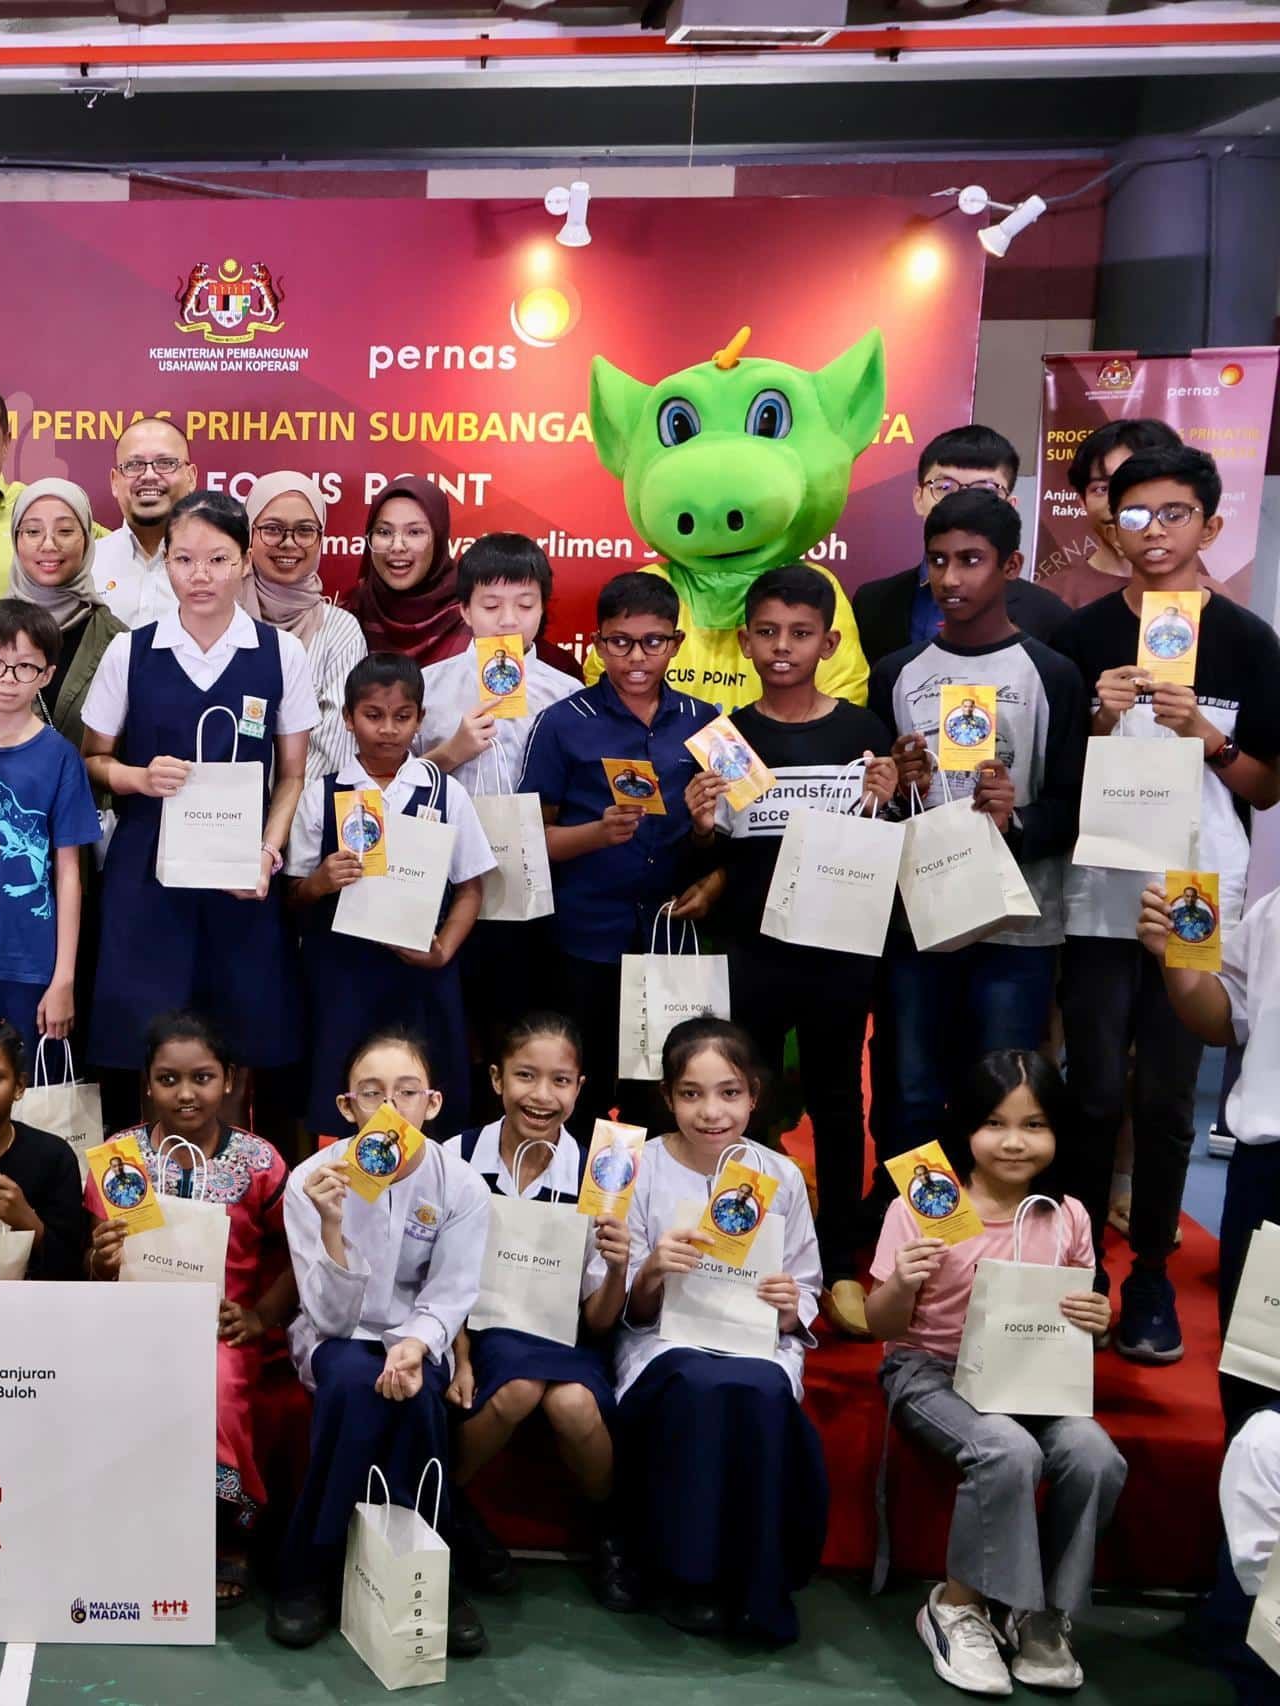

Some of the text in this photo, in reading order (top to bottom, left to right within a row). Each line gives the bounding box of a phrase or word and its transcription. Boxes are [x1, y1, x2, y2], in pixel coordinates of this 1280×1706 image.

[149, 347, 309, 360] KEMENTERIAN PEMBANGUNAN
[367, 343, 517, 378] pernas
[158, 359, 300, 372] USAHAWAN DAN KOPERASI
[1166, 385, 1222, 401] pernas
[186, 411, 357, 442] PRIHATIN
[370, 412, 596, 443] SUMBANGA
[1043, 488, 1080, 504] Anjur
[1051, 504, 1088, 519] Rakya
[665, 667, 747, 687] CUS POINT
[1103, 788, 1171, 799] FOCUS POINT
[184, 811, 243, 821] FOCUS POINT
[915, 847, 973, 876] FOCUS POINT
[398, 867, 426, 879] POINT
[816, 863, 875, 882] FOCUS POINT
[664, 1003, 689, 1012] FOCUS
[143, 1253, 205, 1273] FOCUS POINT
[496, 1250, 562, 1269] FOCUS POINT
[727, 1264, 759, 1279] POINT
[1004, 1323, 1067, 1335] FOCUS POINT
[0, 1367, 57, 1385] anjuran
[89, 1601, 141, 1611] MALAYSIA
[88, 1610, 141, 1621] MADANI
